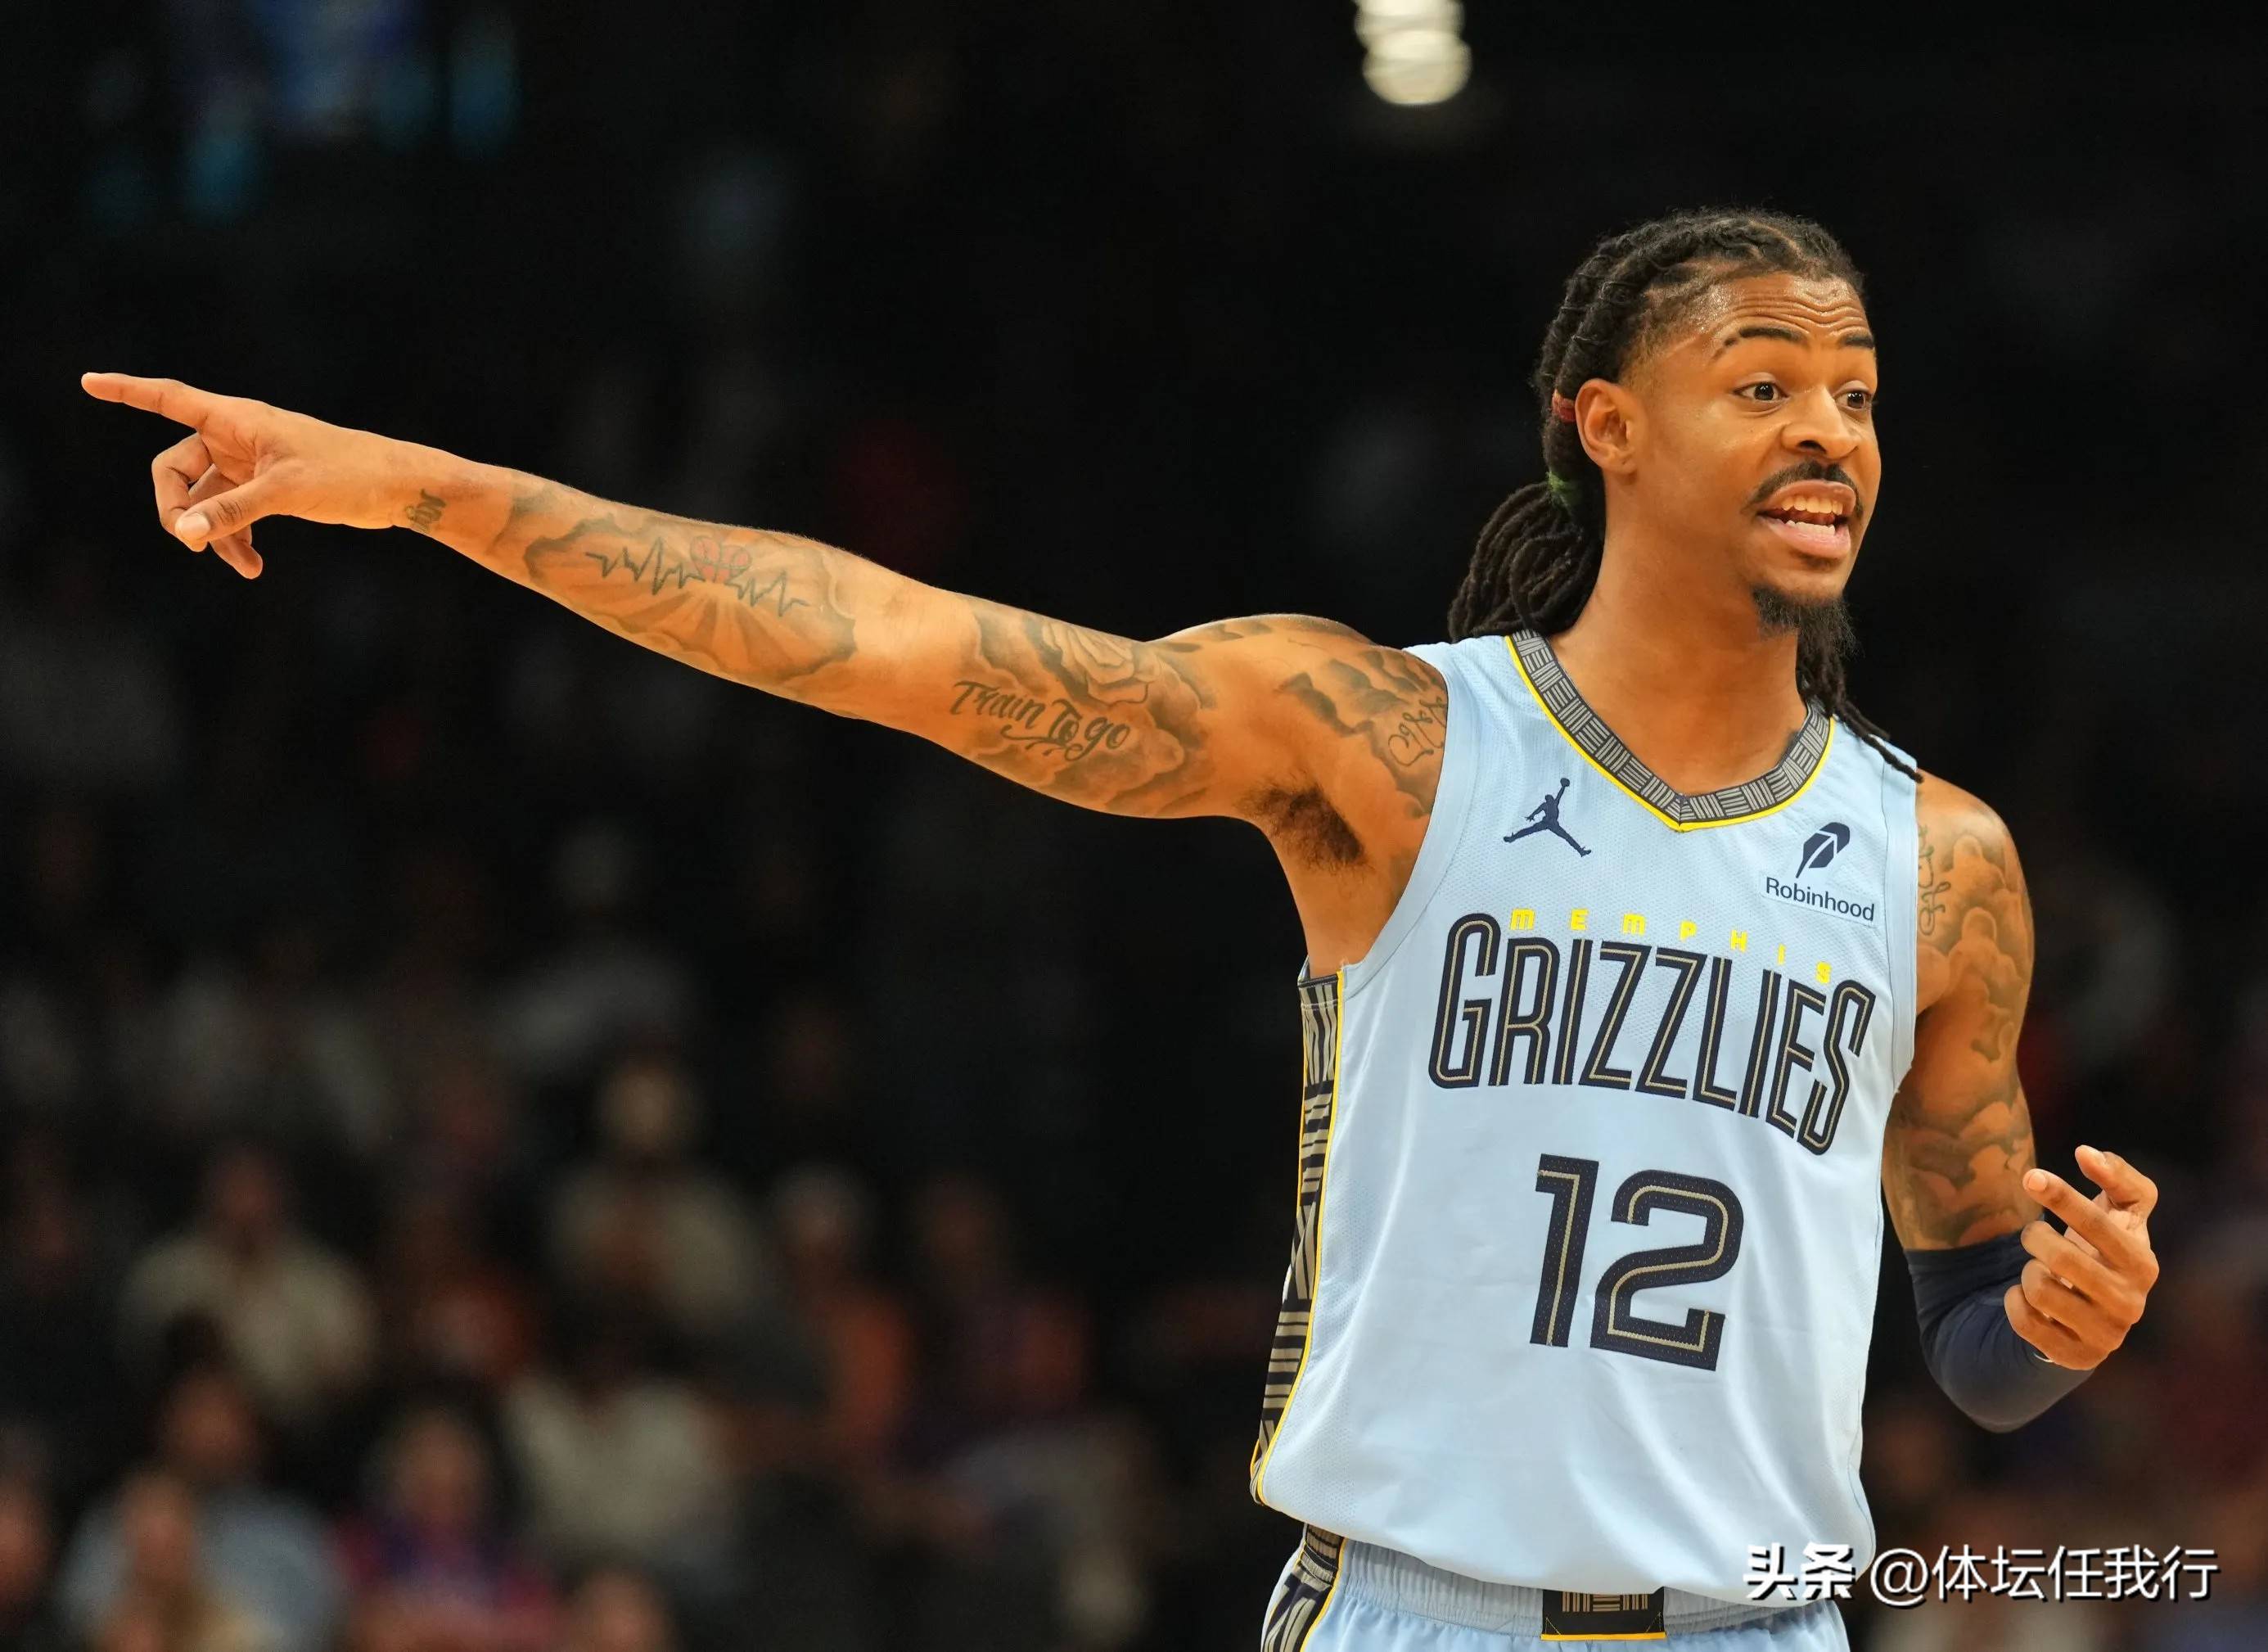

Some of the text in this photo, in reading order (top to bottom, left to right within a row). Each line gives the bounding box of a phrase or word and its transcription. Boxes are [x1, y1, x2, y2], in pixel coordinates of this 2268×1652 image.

[1509, 908, 1833, 985] MEMPHIS
[1766, 876, 1875, 922] Robinhood
[1428, 913, 1876, 1156] GRIZZLIES
[1529, 1153, 1745, 1371] 12
